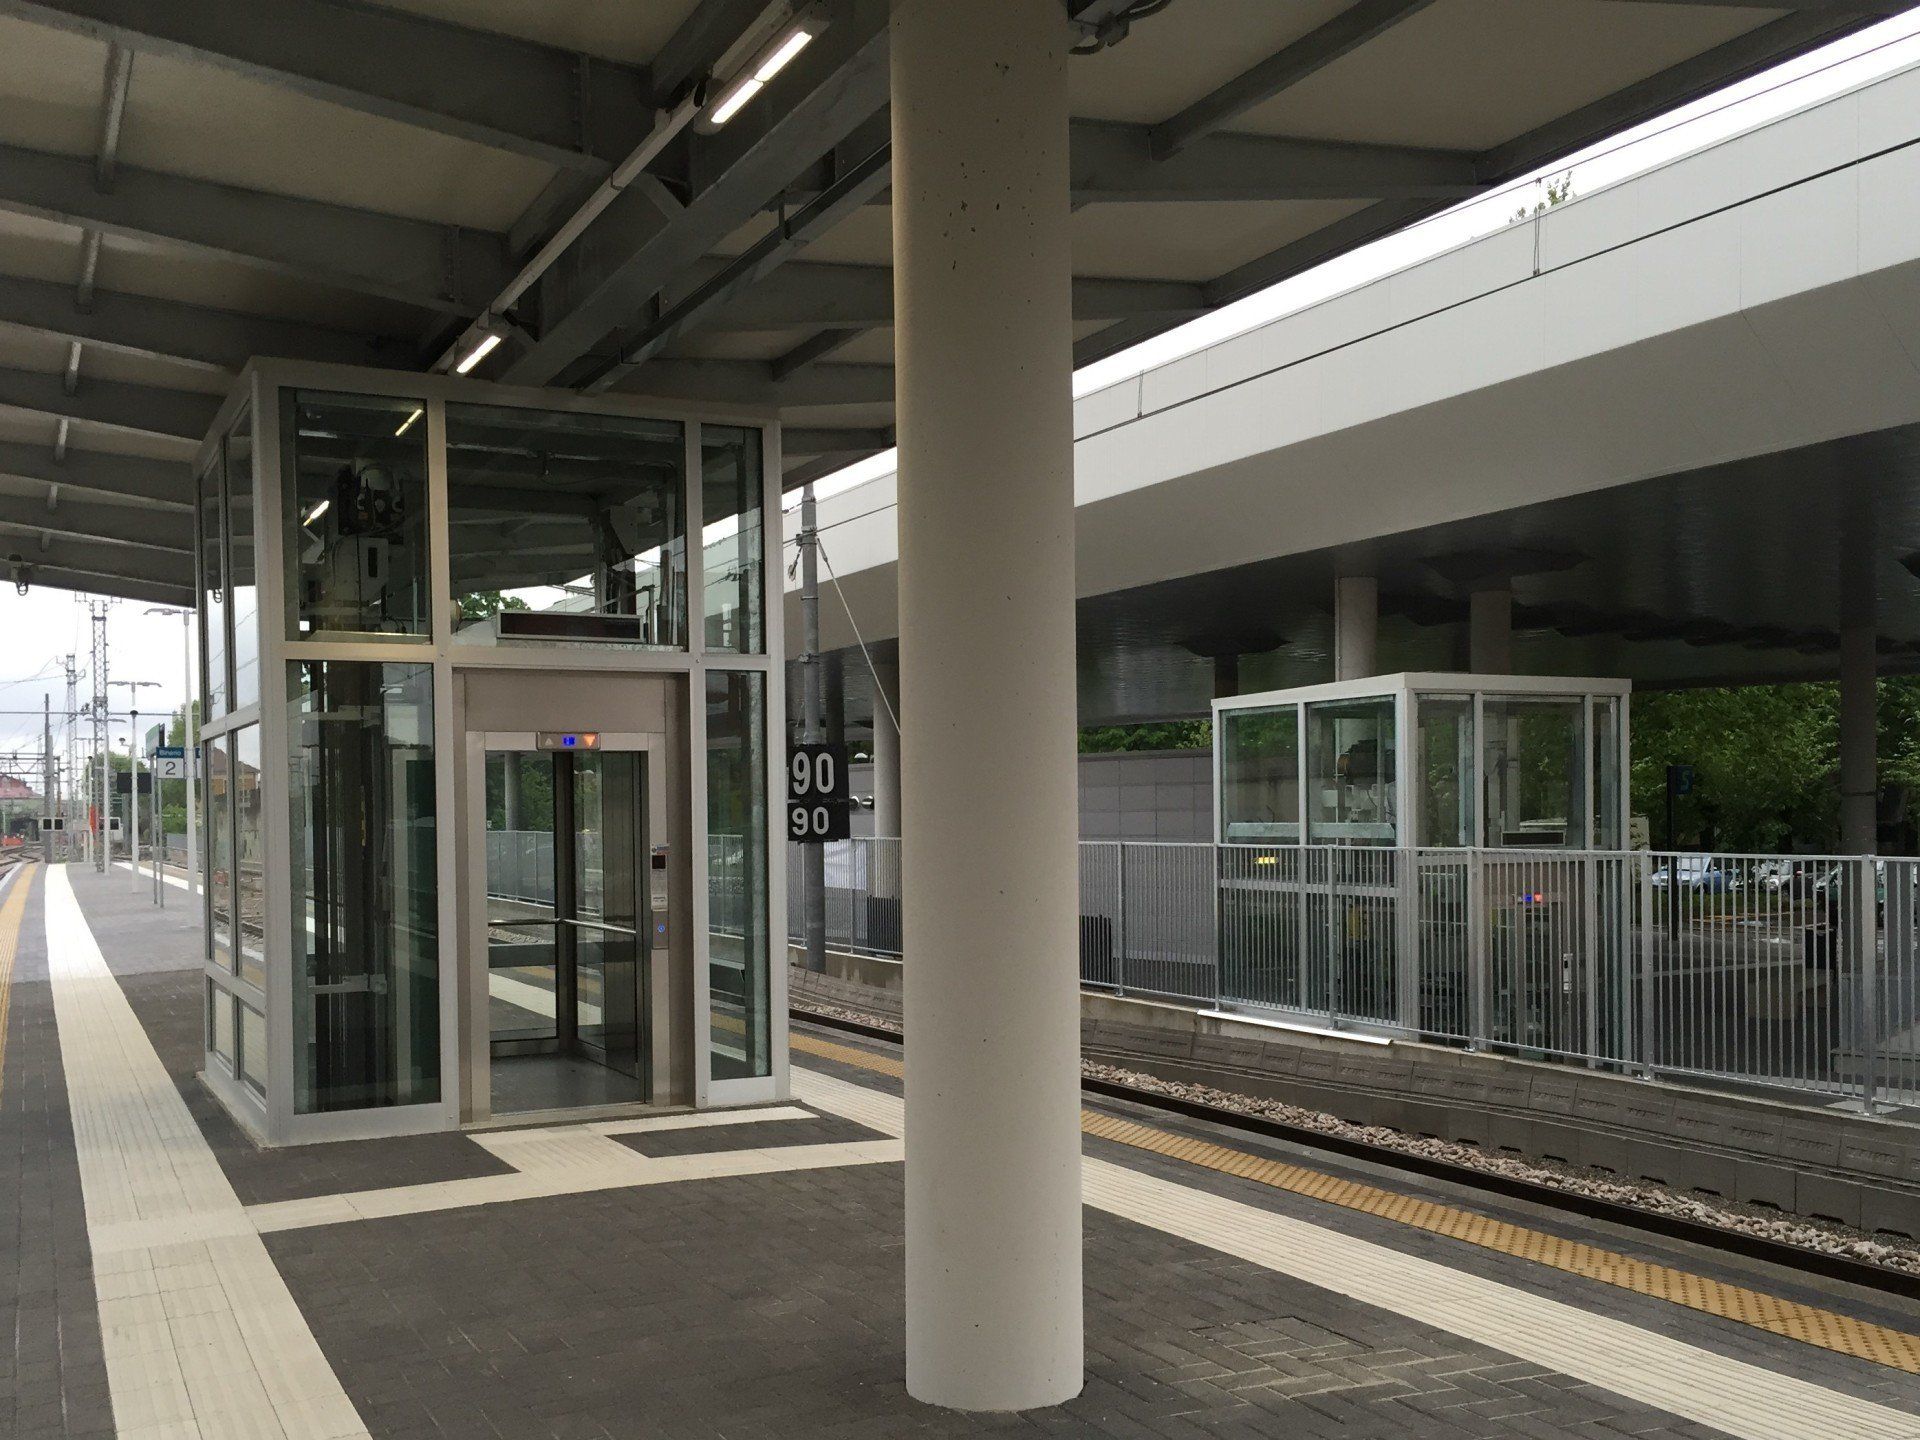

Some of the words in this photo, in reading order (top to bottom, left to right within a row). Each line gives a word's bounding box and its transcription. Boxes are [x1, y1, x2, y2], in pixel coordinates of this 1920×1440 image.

[165, 761, 176, 776] 2
[792, 751, 835, 795] 90
[791, 806, 830, 836] 90
